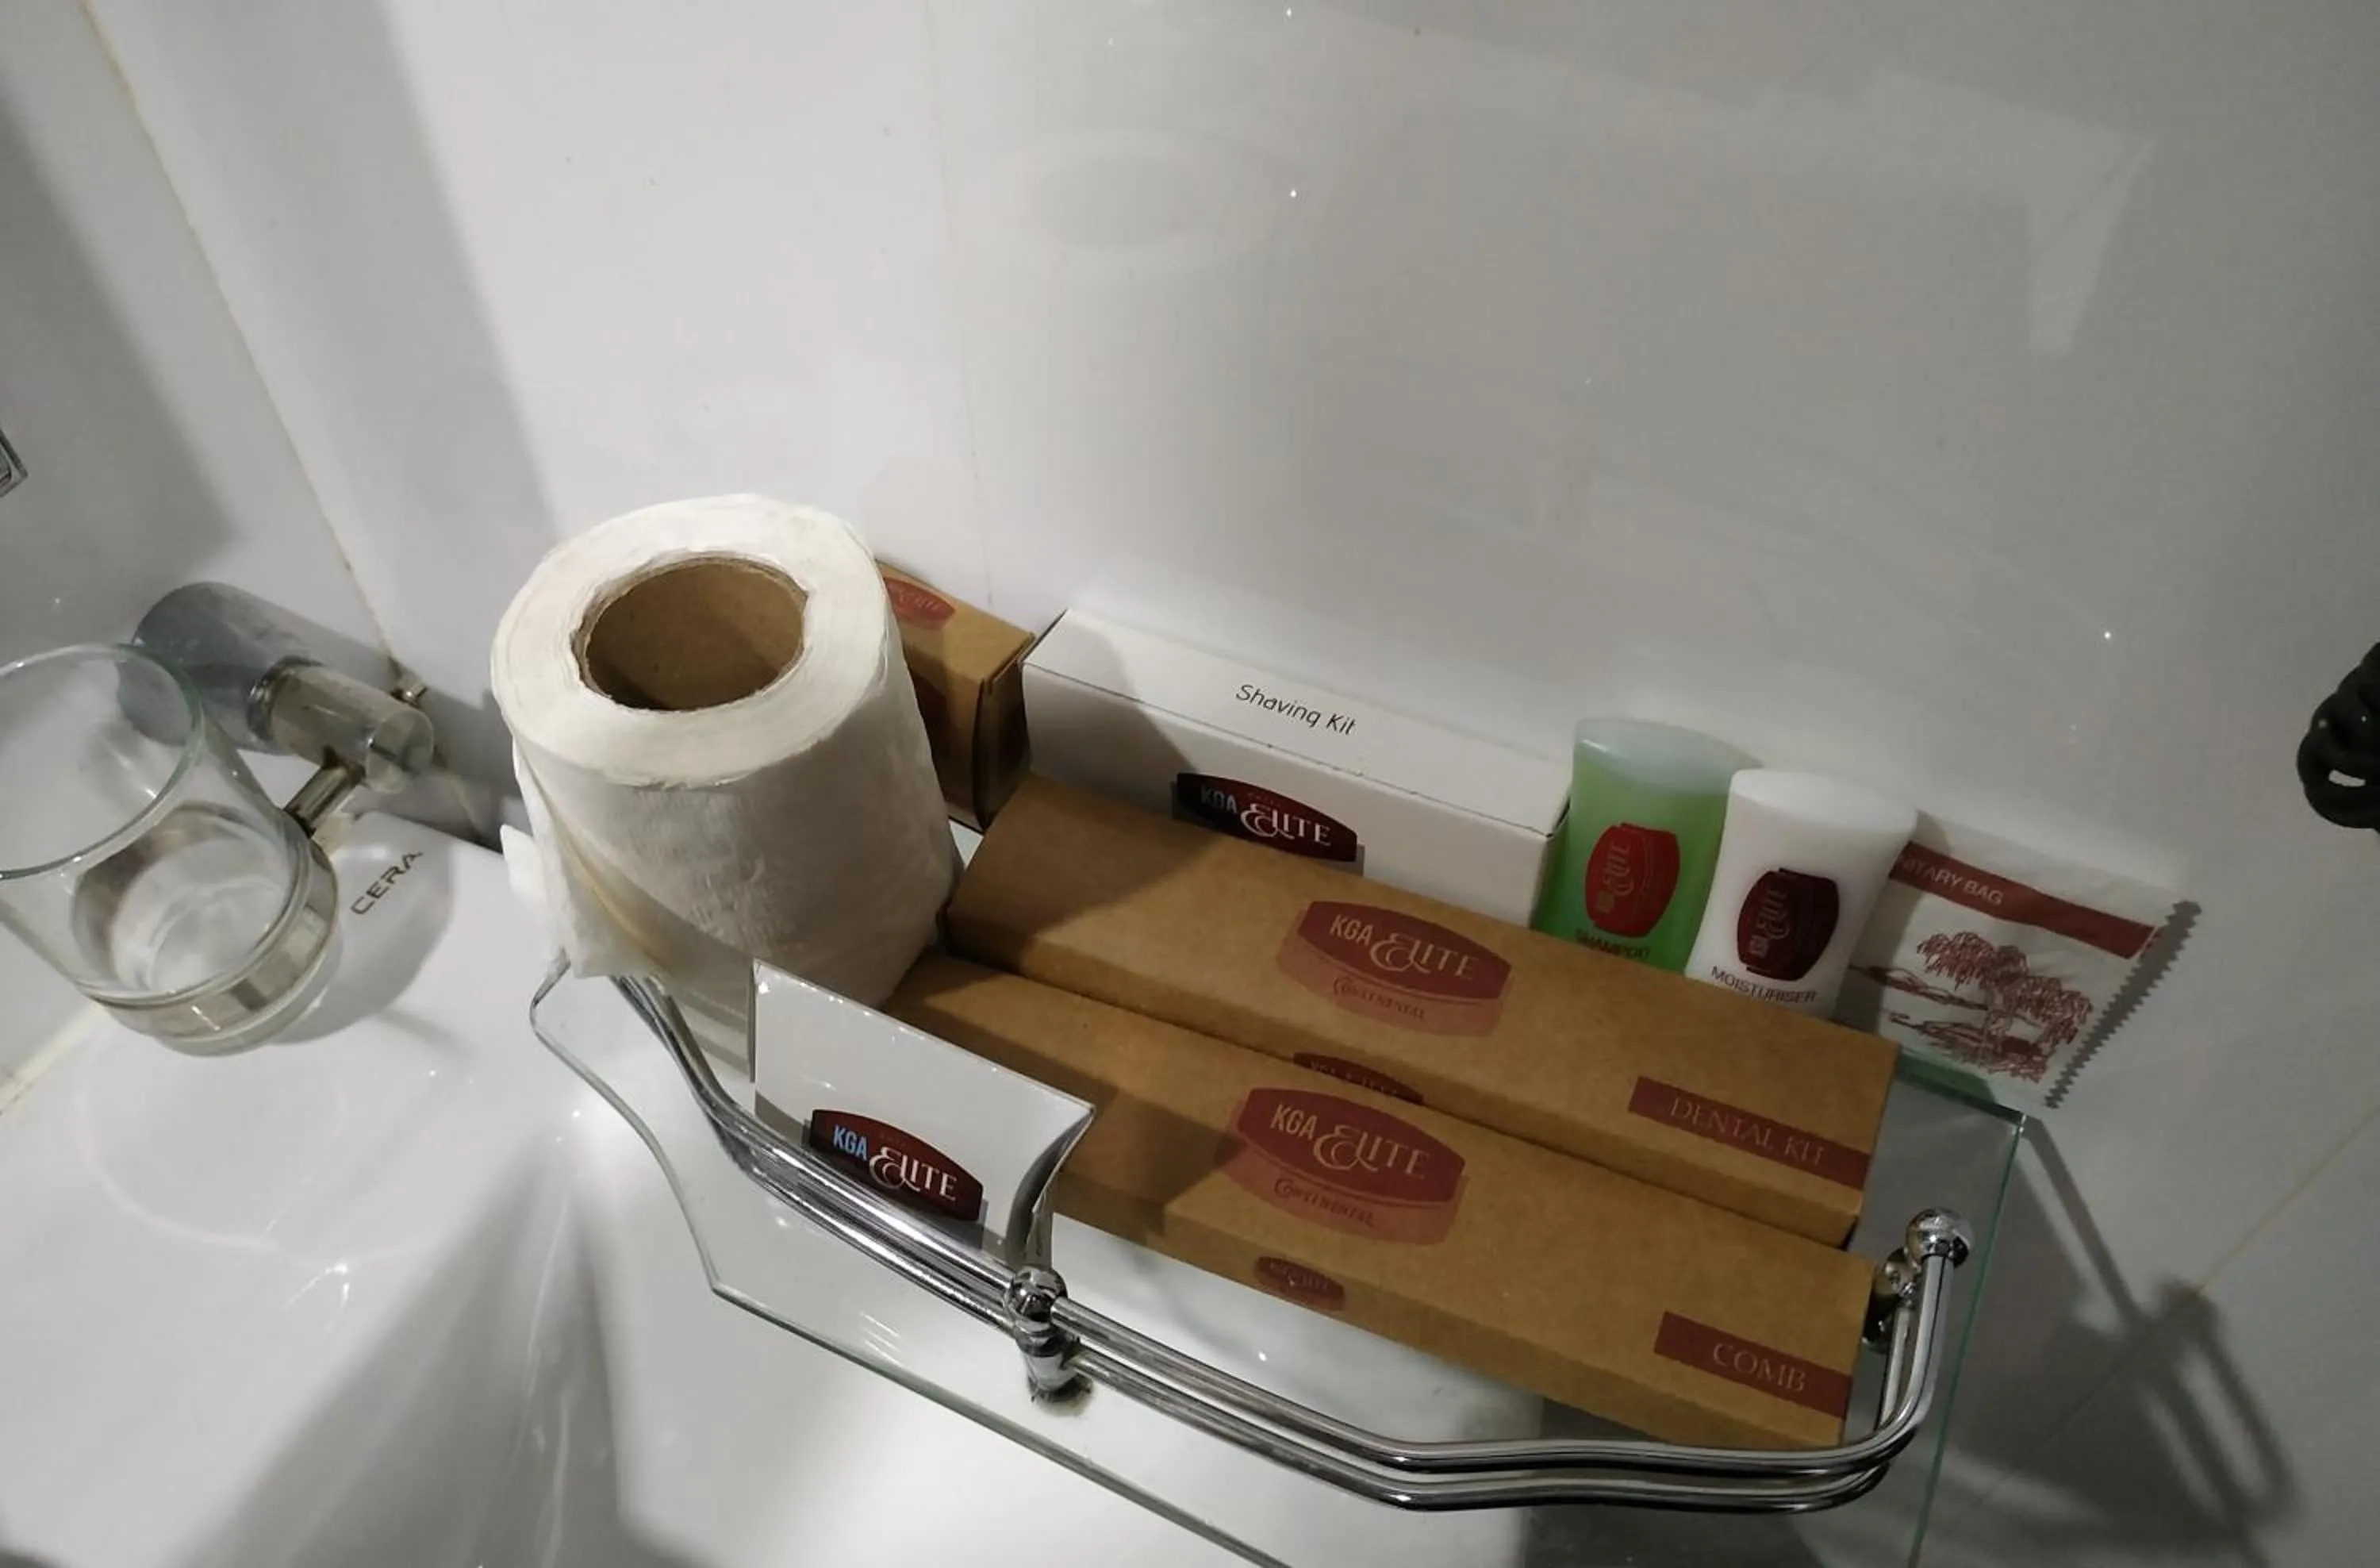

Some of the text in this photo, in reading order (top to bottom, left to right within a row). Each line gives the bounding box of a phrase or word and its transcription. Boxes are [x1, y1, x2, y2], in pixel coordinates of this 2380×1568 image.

[1235, 683, 1357, 736] Shaving Kit
[350, 851, 424, 915] CERA
[1964, 878, 2005, 906] BAG
[1329, 913, 1480, 981] KGA ELITE
[1710, 965, 1818, 1004] MOISTURISER
[833, 1124, 958, 1202] KGA ELITE
[1270, 1103, 1432, 1180] KGA ELITE
[1669, 1097, 1825, 1166] DENTAL KIT
[1712, 1342, 1806, 1393] COMB
